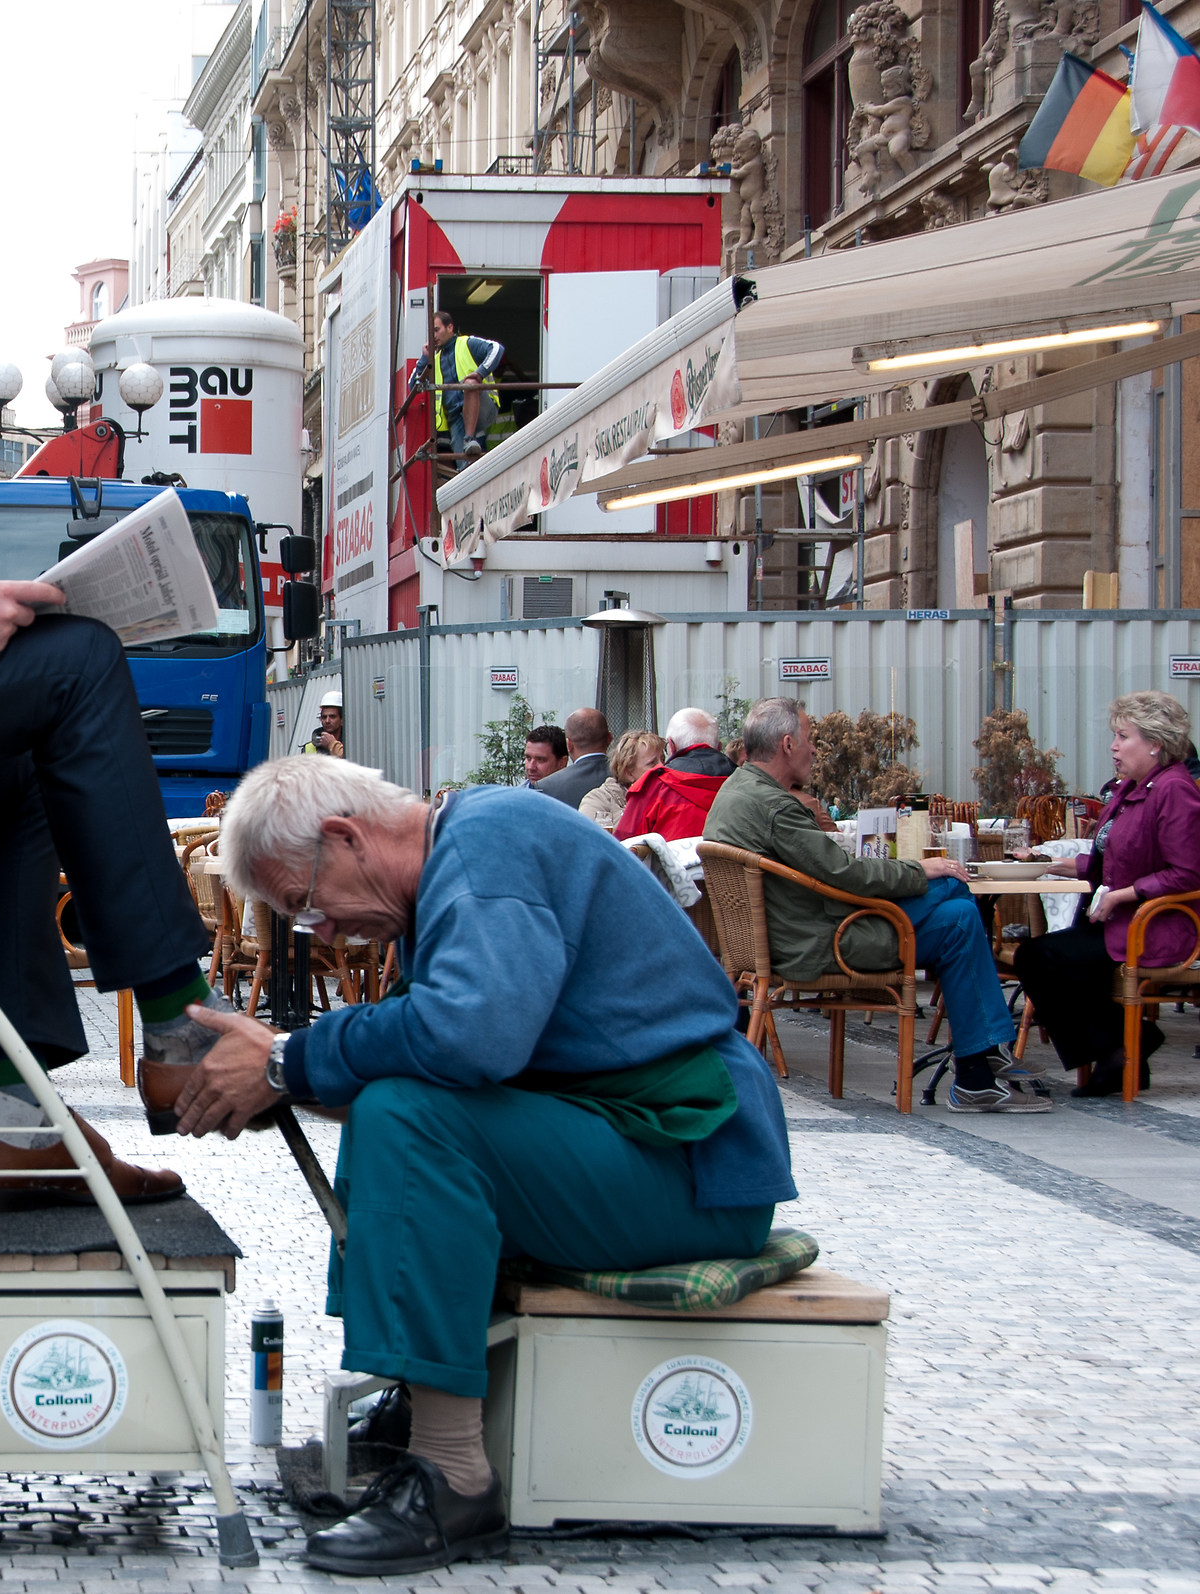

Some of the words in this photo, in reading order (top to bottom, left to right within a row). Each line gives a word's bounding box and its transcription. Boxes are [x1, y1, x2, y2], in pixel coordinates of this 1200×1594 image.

[336, 501, 374, 567] STRABAG
[908, 611, 948, 619] HERAS
[782, 665, 828, 674] STRABAG
[35, 1393, 93, 1406] Collonil
[24, 1403, 103, 1431] INTERPOLISH
[664, 1423, 718, 1437] Collonil
[653, 1434, 726, 1461] INTERPOLISH
